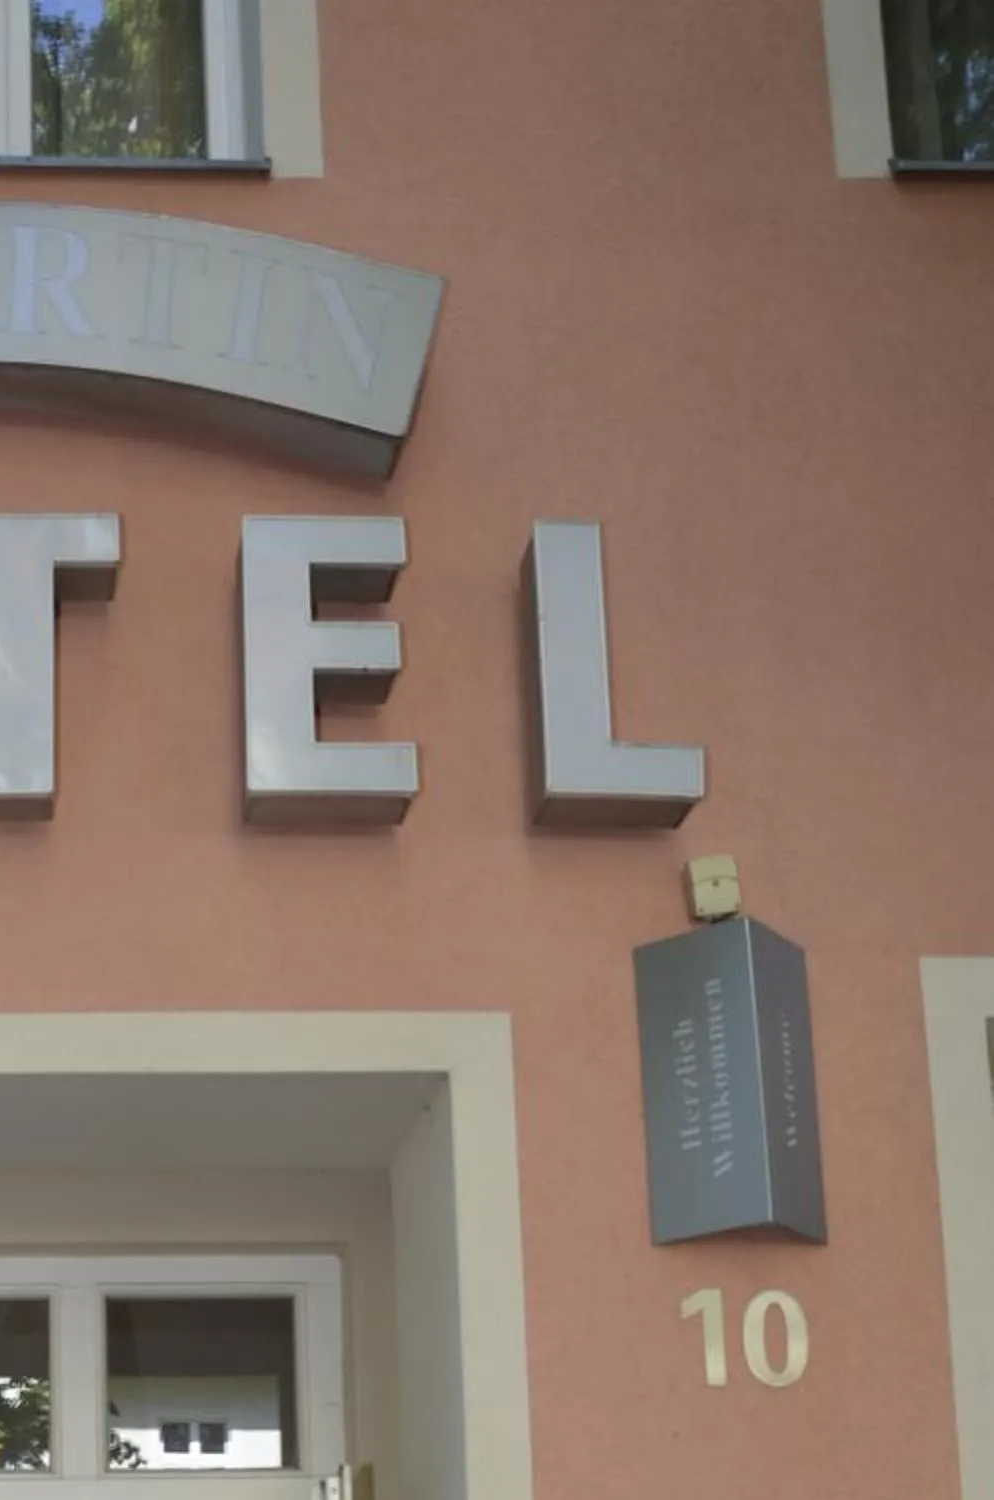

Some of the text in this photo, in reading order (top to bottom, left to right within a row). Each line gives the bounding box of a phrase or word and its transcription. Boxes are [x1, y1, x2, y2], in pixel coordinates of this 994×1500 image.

[674, 1017, 704, 1153] Herzlich
[703, 977, 734, 1180] Willkommen
[680, 1287, 811, 1389] 10
